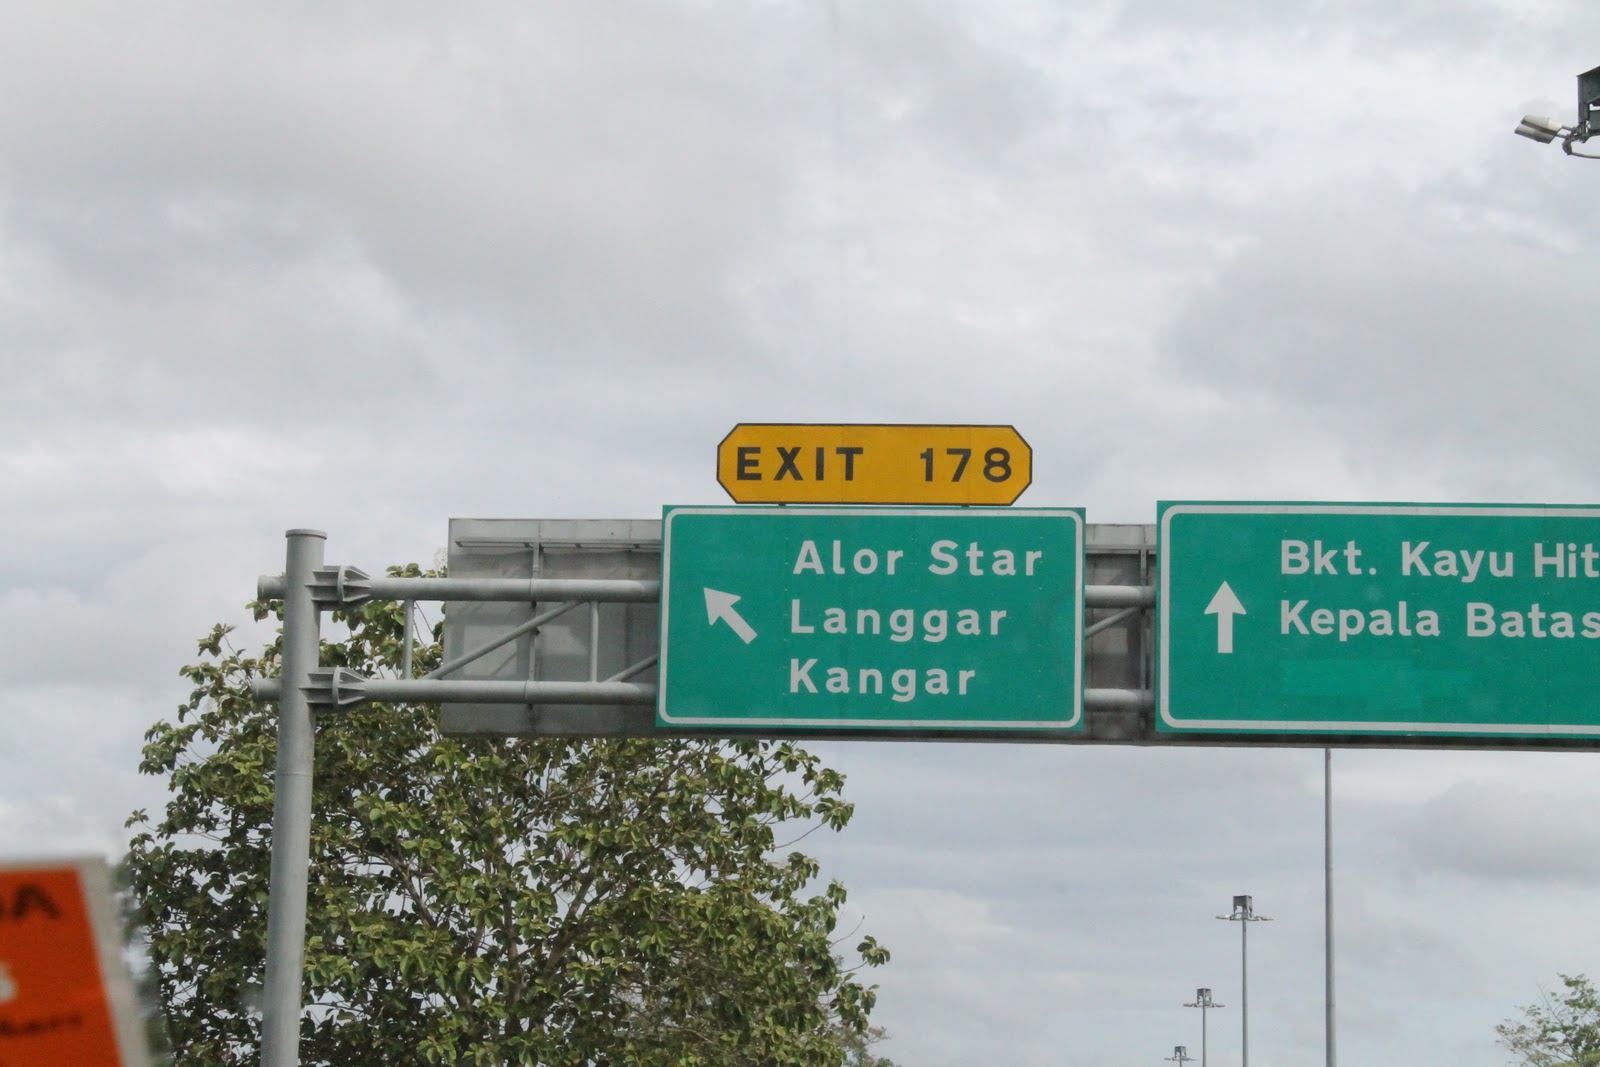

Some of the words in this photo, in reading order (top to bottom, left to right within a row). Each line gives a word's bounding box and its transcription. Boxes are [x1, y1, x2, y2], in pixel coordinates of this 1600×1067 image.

[737, 447, 863, 480] EXIT
[920, 447, 1011, 482] 178
[794, 541, 903, 574] Alor
[929, 540, 1041, 575] Star
[1282, 540, 1376, 574] Bkt.
[1402, 542, 1513, 582] Kayu
[792, 600, 1006, 642] Langgar
[1281, 600, 1440, 641] Kepala
[1467, 603, 1600, 638] Batas
[791, 659, 975, 702] Kangar
